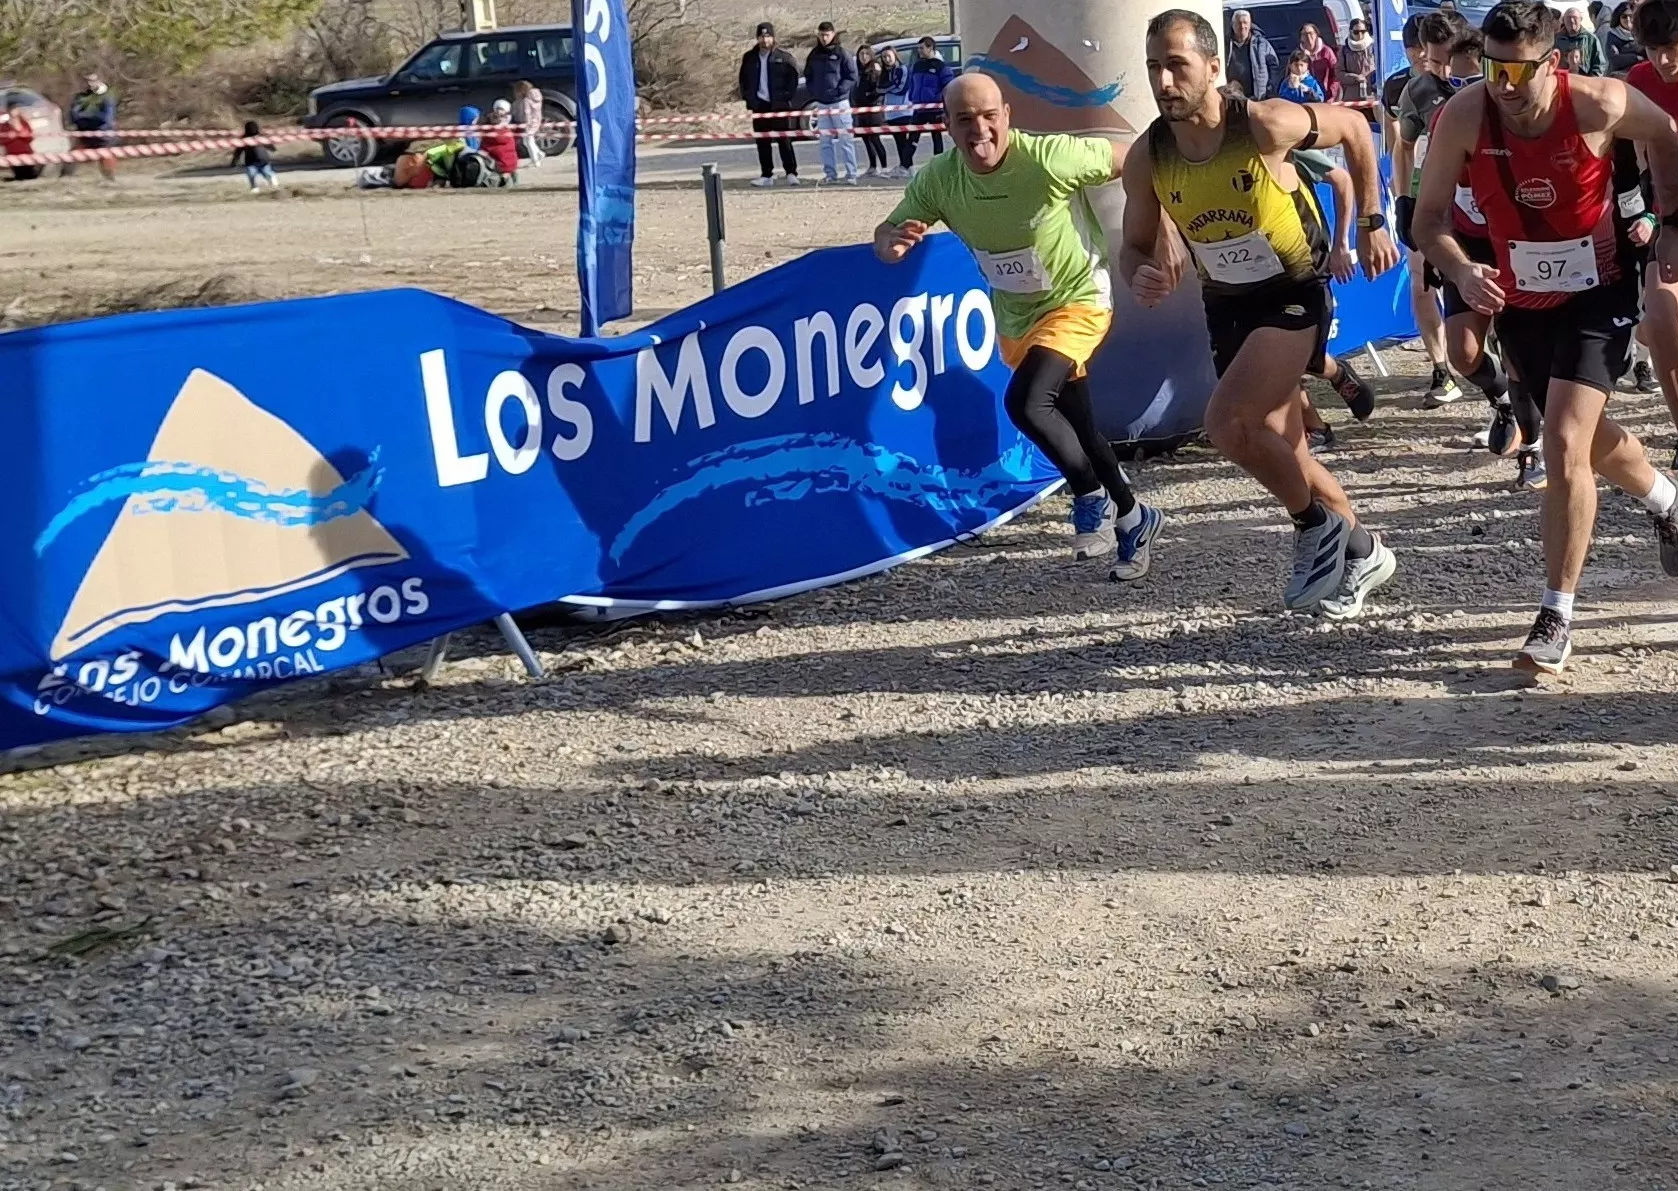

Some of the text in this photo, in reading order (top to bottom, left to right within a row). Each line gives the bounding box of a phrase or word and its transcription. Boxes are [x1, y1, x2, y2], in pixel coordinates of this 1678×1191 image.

[1186, 208, 1254, 235] MATARRAÑA
[996, 261, 1024, 275] 120
[1219, 249, 1252, 264] 122
[1537, 260, 1567, 280] 97
[420, 288, 996, 488] Los Monegro
[159, 577, 429, 674] Monegros
